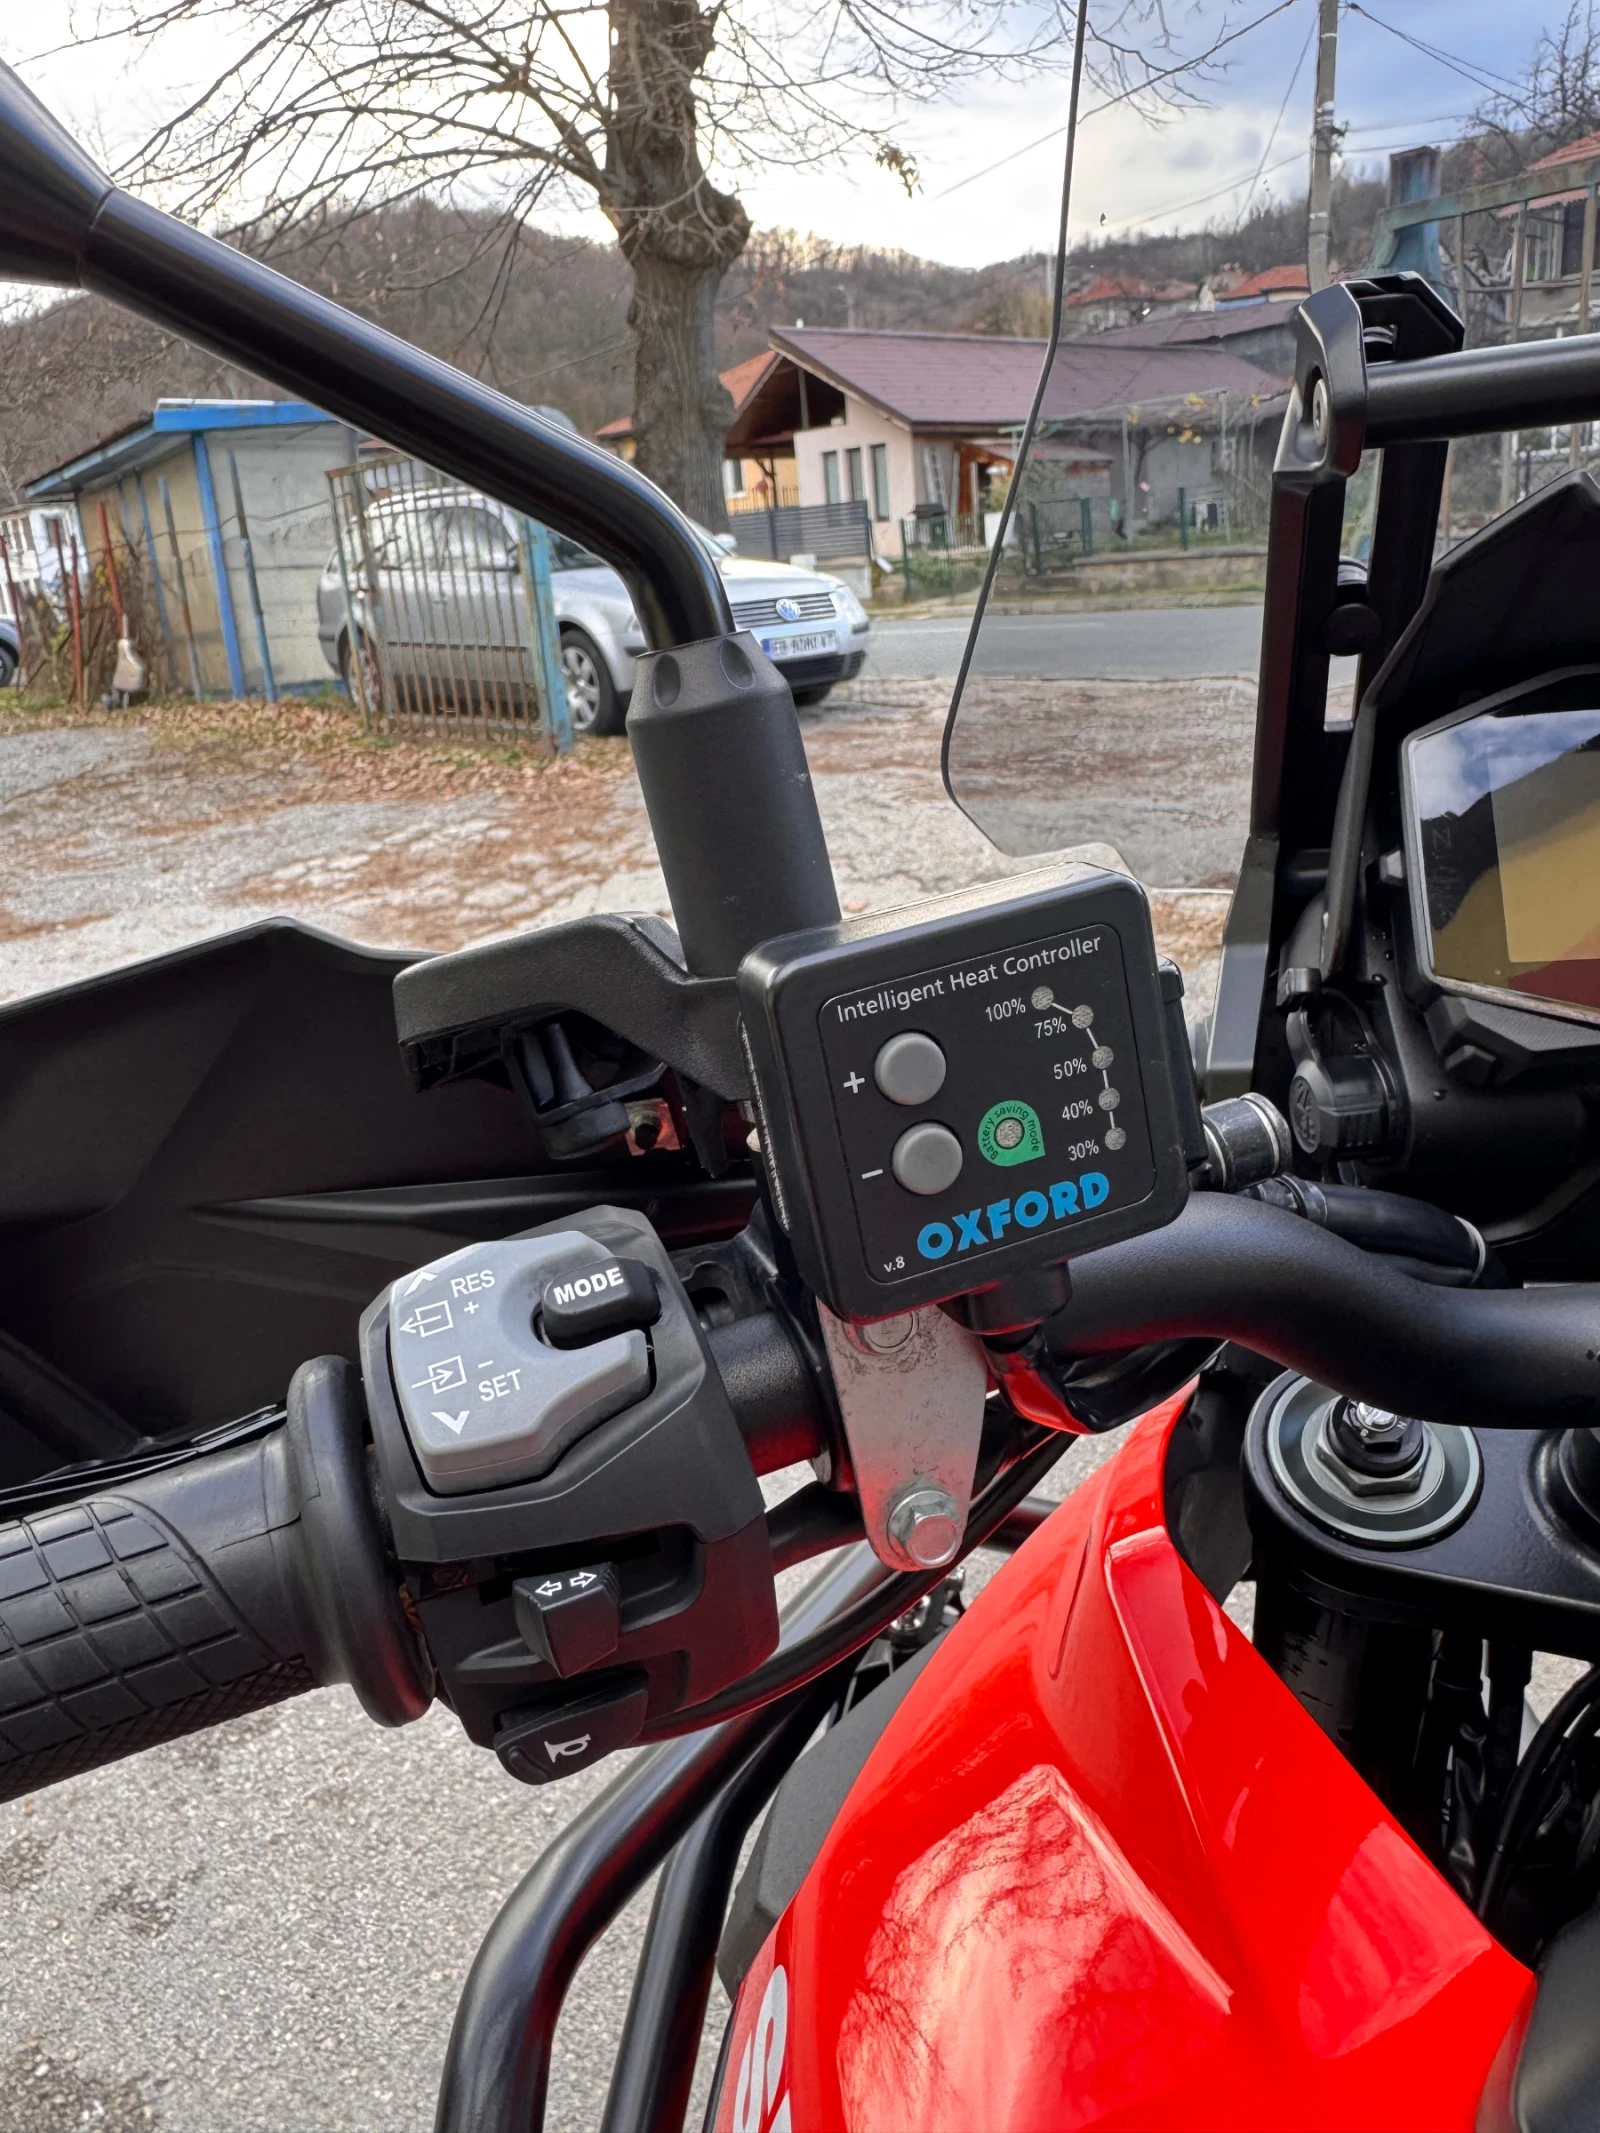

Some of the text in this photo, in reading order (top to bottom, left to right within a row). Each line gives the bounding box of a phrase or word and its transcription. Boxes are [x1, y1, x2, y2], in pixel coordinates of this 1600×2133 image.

[837, 937, 1101, 1022] Intelligent Heat Controller
[985, 998, 1026, 1022] 100%
[1034, 1016, 1067, 1038] 75%
[1054, 1057, 1087, 1080] 50%
[1061, 1099, 1093, 1121] 40%
[981, 1102, 1041, 1160] Battery saving mode
[1068, 1139, 1100, 1161] 30%
[917, 1172, 1110, 1259] OXFORD
[884, 1255, 905, 1273] v.8
[450, 1269, 496, 1298] RES
[553, 1267, 624, 1305] MODE
[478, 1369, 521, 1401] SET
